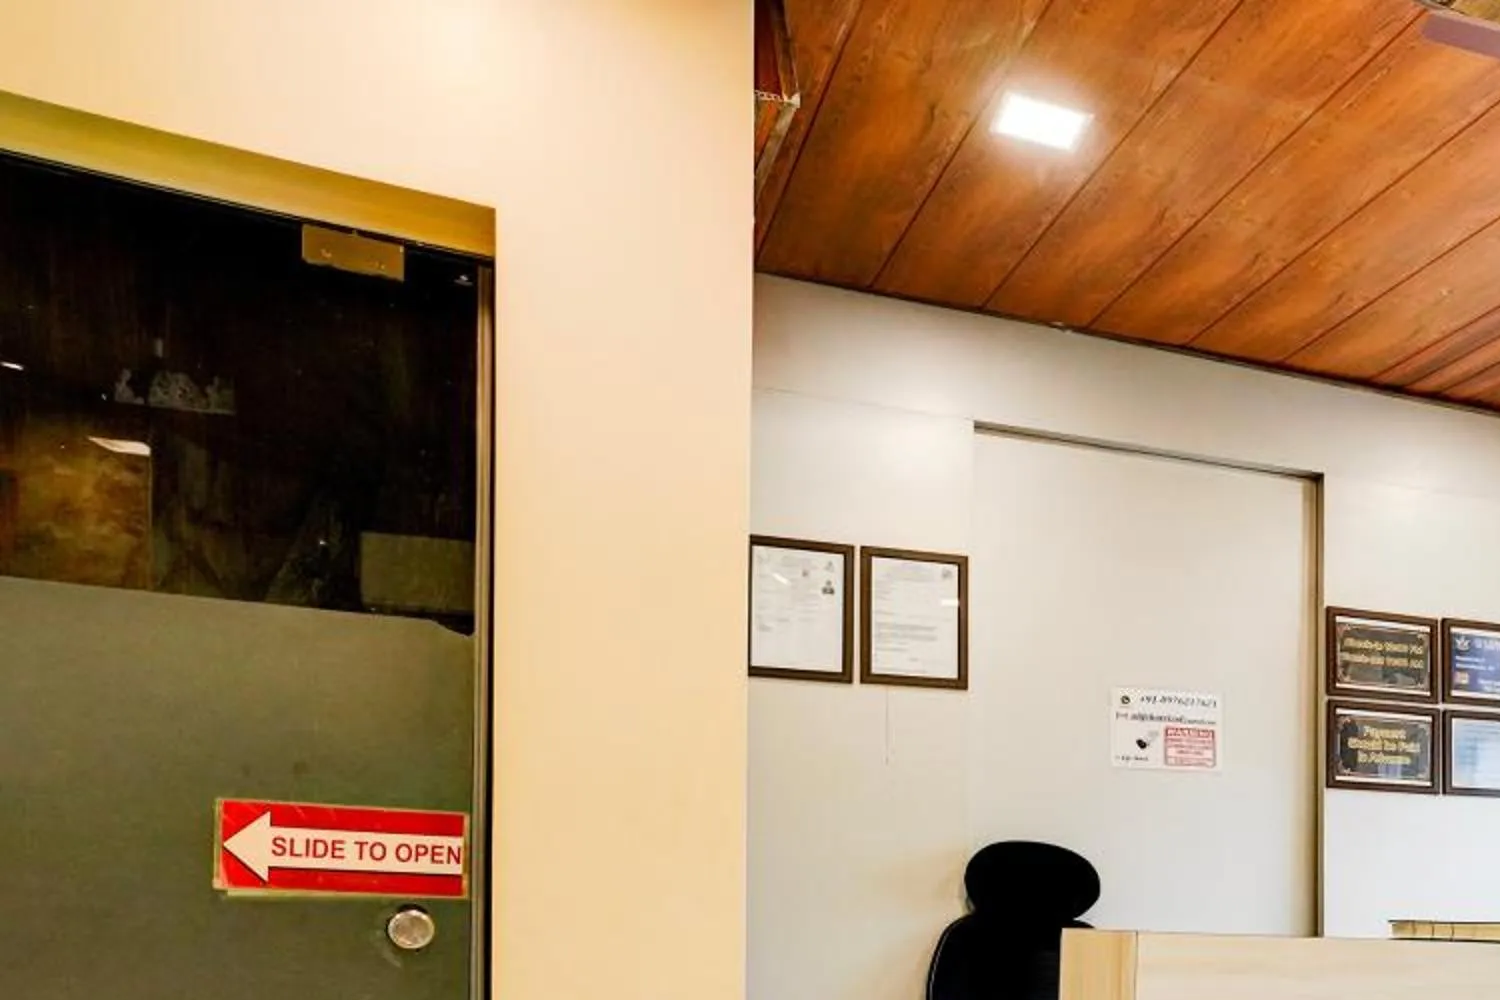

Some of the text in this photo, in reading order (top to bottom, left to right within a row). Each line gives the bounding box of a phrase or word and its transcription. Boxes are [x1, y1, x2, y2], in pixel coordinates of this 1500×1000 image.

[271, 835, 462, 865] SLIDE TO OPEN
